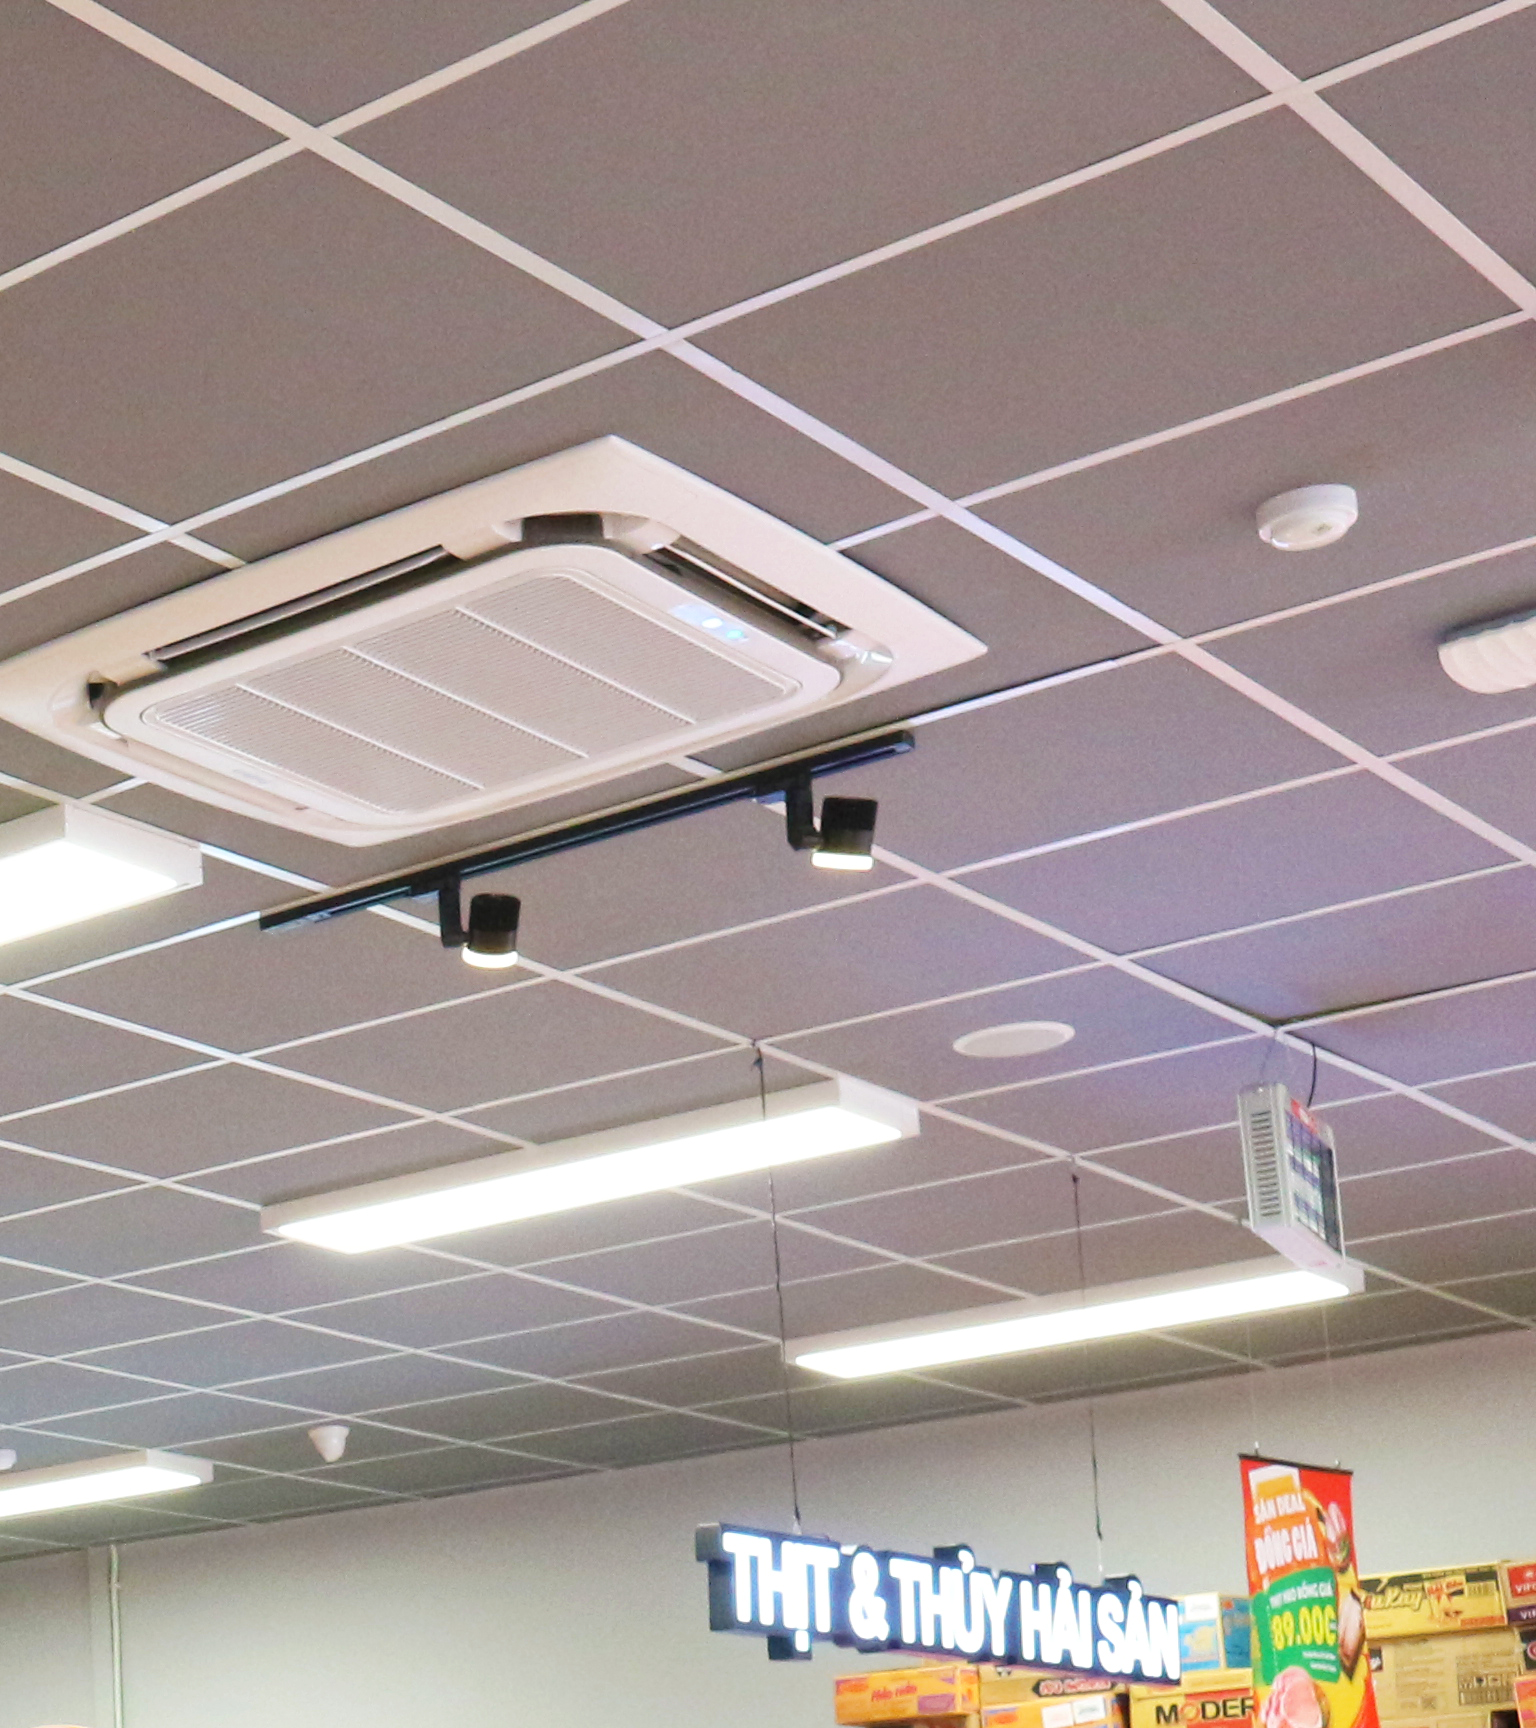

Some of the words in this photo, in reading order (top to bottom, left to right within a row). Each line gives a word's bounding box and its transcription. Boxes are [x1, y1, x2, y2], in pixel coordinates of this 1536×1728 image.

[1292, 1518, 1318, 1561] GIÁ
[722, 1530, 839, 1653] THỊT
[848, 1546, 889, 1640] &
[890, 1544, 1019, 1660] THỦY
[1022, 1564, 1095, 1674] HẢI
[1099, 1579, 1181, 1682] SẢN
